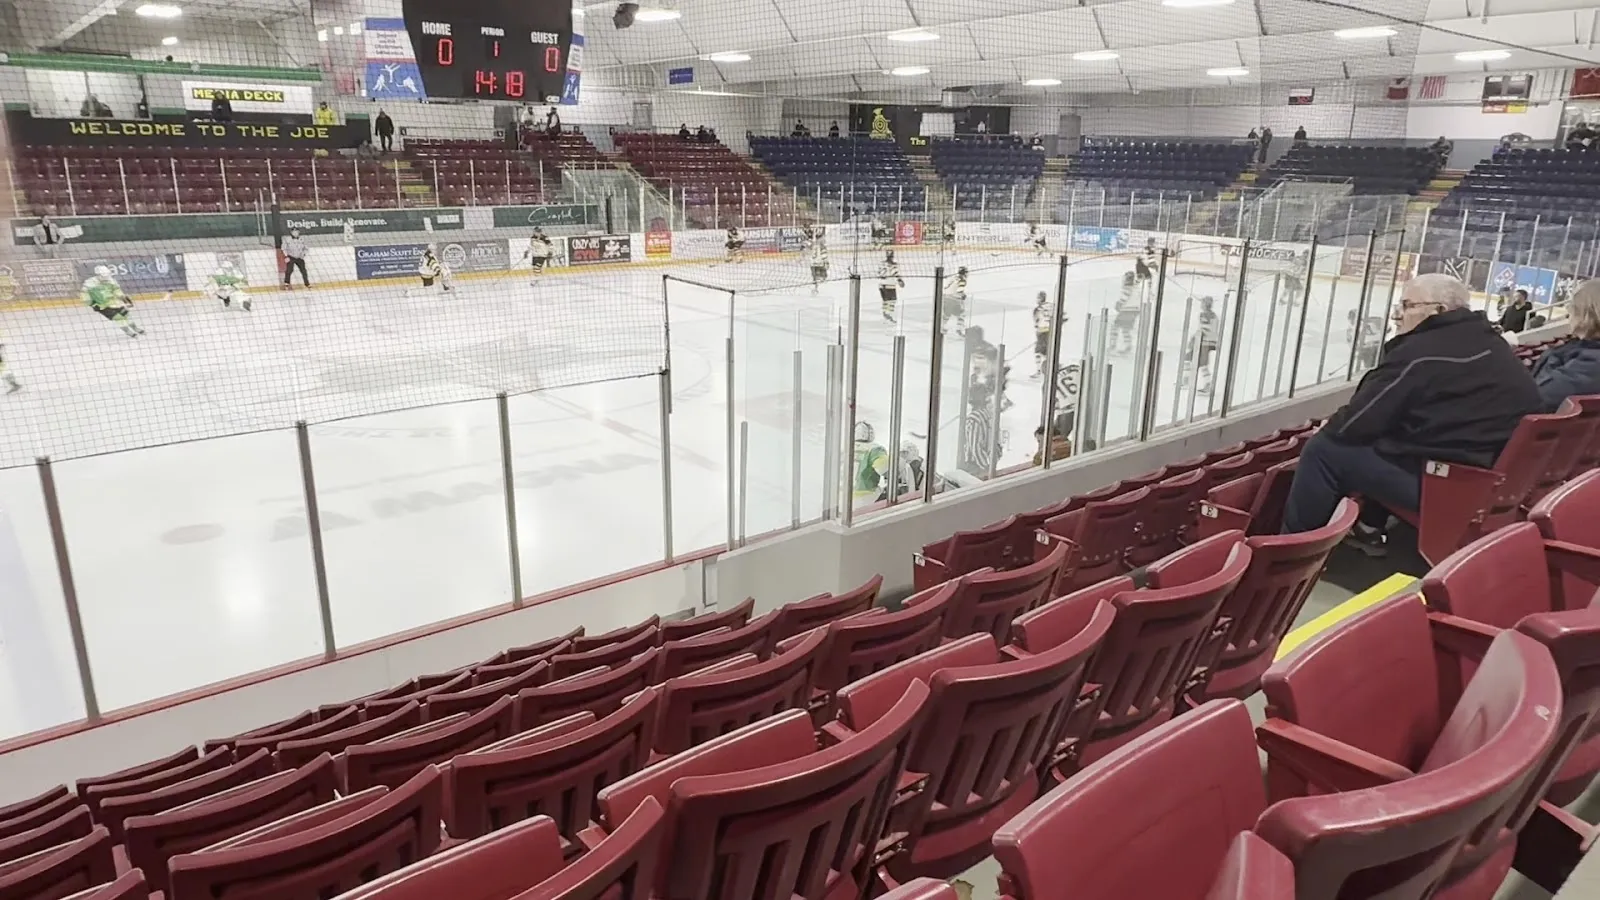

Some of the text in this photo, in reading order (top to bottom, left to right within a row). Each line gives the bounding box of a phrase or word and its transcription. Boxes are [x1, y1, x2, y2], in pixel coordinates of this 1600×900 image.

[422, 22, 559, 45] HOME PERIOD GUEST
[438, 39, 453, 65] 0
[545, 47, 559, 72] 0
[192, 88, 283, 102] MEIA DECK
[70, 121, 330, 139] WELCOME TO THE JOE
[909, 137, 926, 146] The
[286, 219, 319, 230] Design.
